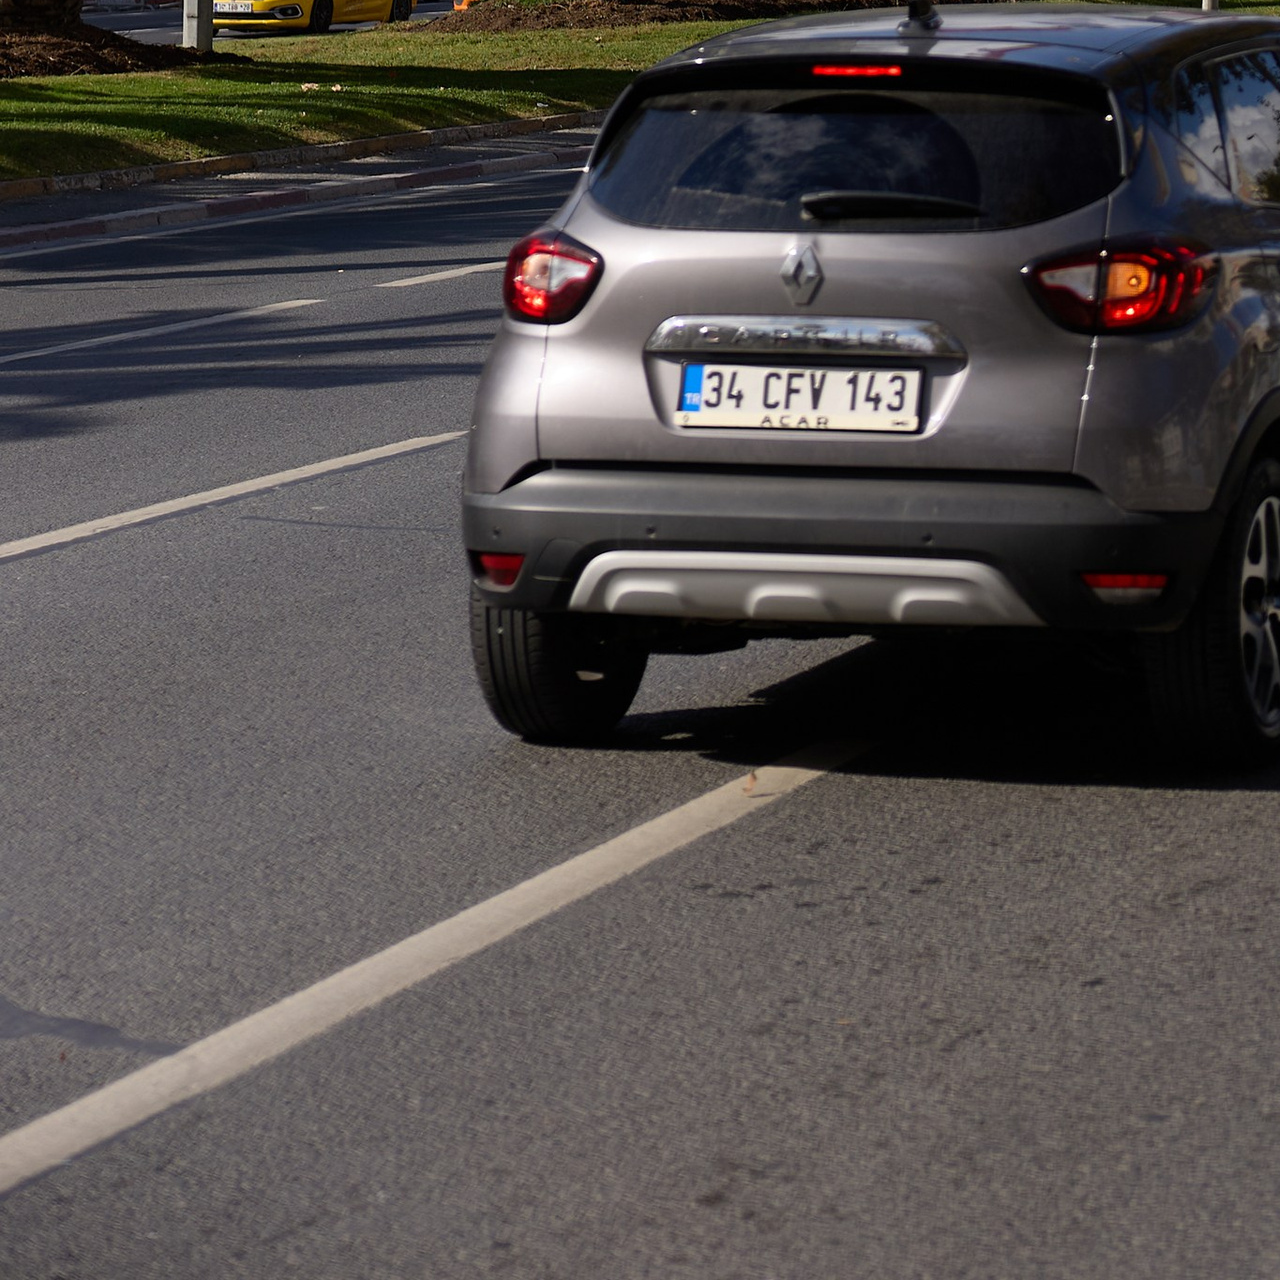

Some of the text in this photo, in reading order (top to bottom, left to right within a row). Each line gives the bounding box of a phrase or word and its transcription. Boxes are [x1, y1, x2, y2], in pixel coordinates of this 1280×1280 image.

[703, 371, 744, 409] 34
[762, 372, 828, 410] CFV
[846, 373, 907, 412] 143
